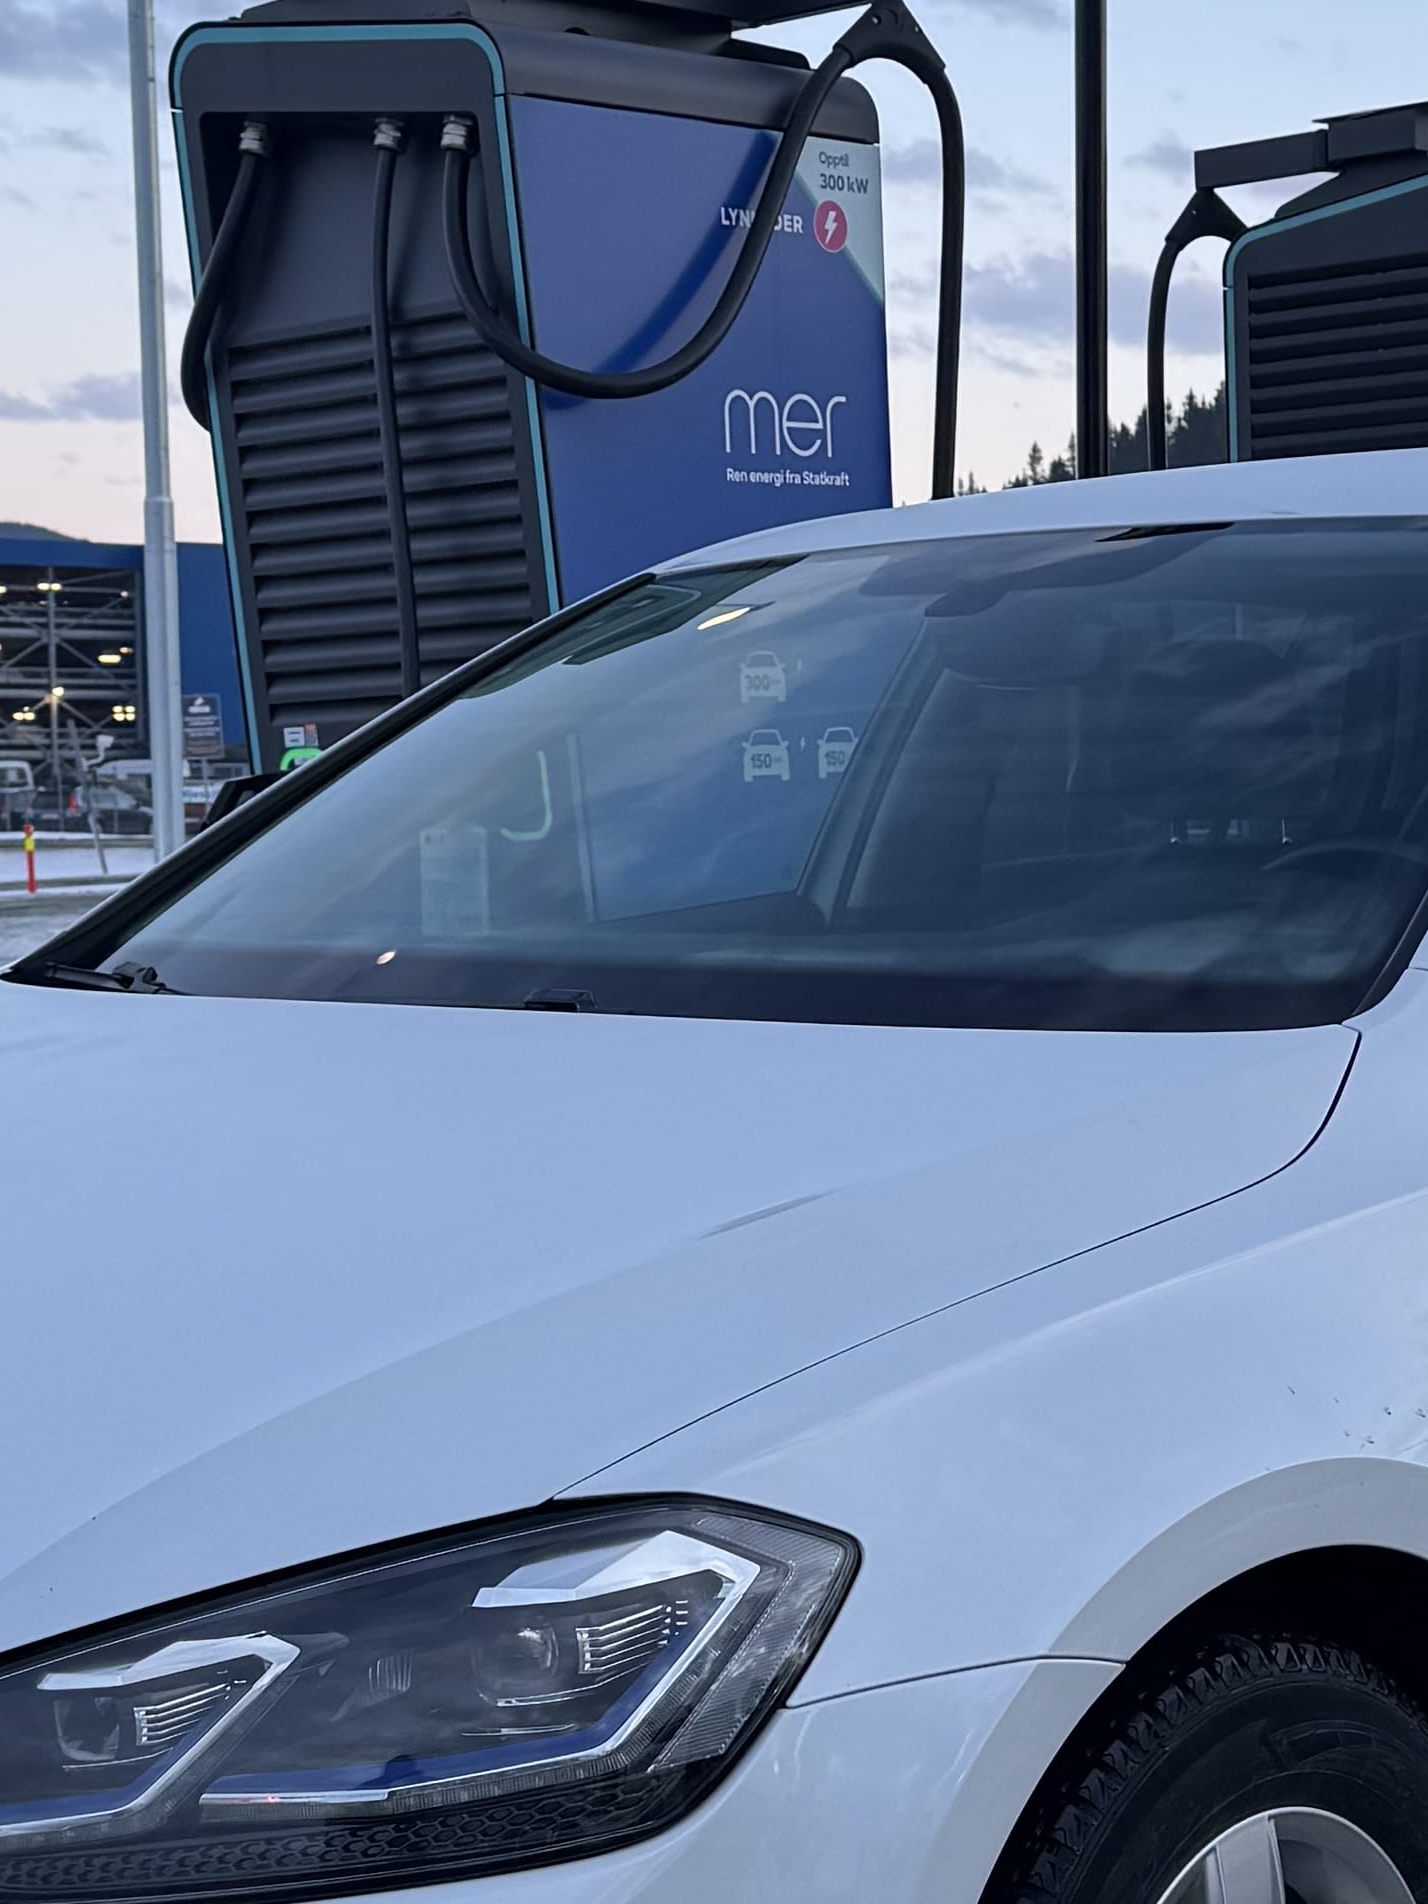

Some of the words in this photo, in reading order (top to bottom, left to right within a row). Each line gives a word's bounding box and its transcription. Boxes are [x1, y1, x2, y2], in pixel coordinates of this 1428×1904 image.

[818, 151, 849, 169] Opptil
[820, 173, 844, 191] 300
[847, 176, 869, 194] kW
[723, 388, 847, 458] mer
[726, 467, 748, 482] Ren
[749, 469, 784, 487] energi
[785, 469, 801, 485] fra
[802, 470, 850, 487] Statkraft
[744, 674, 771, 691] 300
[751, 752, 771, 769] 150
